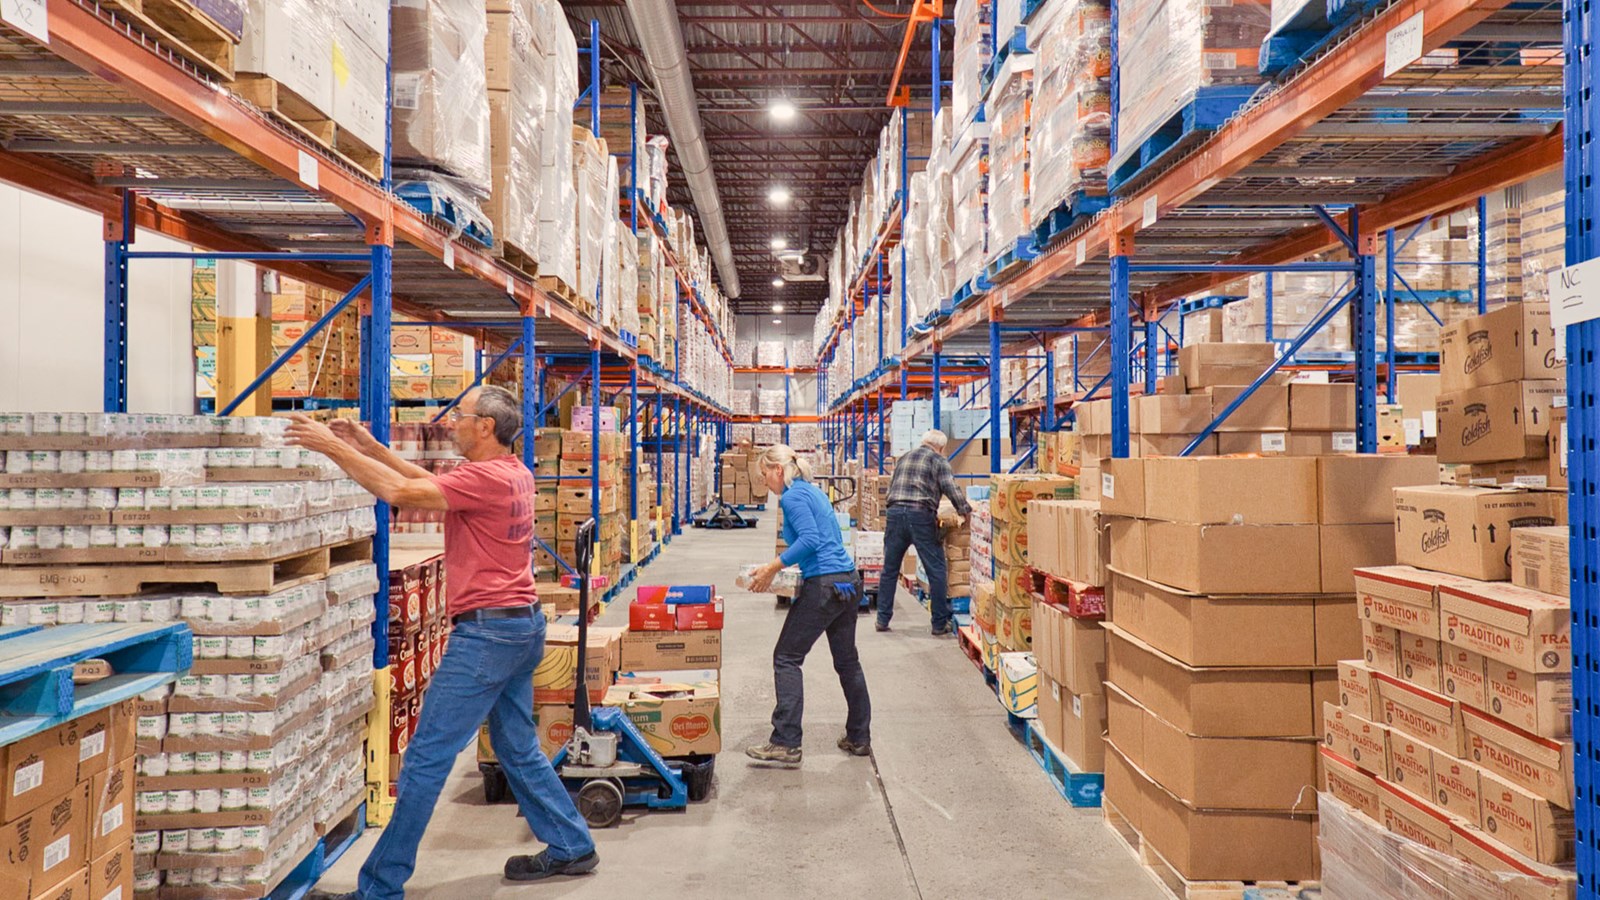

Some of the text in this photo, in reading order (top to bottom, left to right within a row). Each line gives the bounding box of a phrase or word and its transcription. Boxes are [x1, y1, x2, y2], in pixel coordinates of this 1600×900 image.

[1464, 341, 1492, 375] Goldfish
[1461, 414, 1491, 447] Goldfish
[1421, 524, 1450, 553] Goldfish
[1373, 601, 1418, 621] TRADITION
[1365, 635, 1394, 650] TRADITION
[1459, 622, 1510, 649] TRADITION
[1404, 649, 1437, 667] TRADITION
[1444, 662, 1482, 683] TRADITION
[1340, 679, 1368, 694] TRADITION
[1490, 680, 1534, 706] TRADITION
[685, 721, 707, 730] Monte
[1326, 720, 1350, 737] TRADITIO
[1395, 708, 1437, 735] TRADITION
[1352, 733, 1383, 752] TRADITION
[1394, 752, 1429, 776] TRADITION
[1484, 744, 1540, 780] TRADITION
[1436, 772, 1476, 799] TRADITION
[1485, 799, 1532, 831] TRADITION
[1394, 816, 1437, 849] TRADITION
